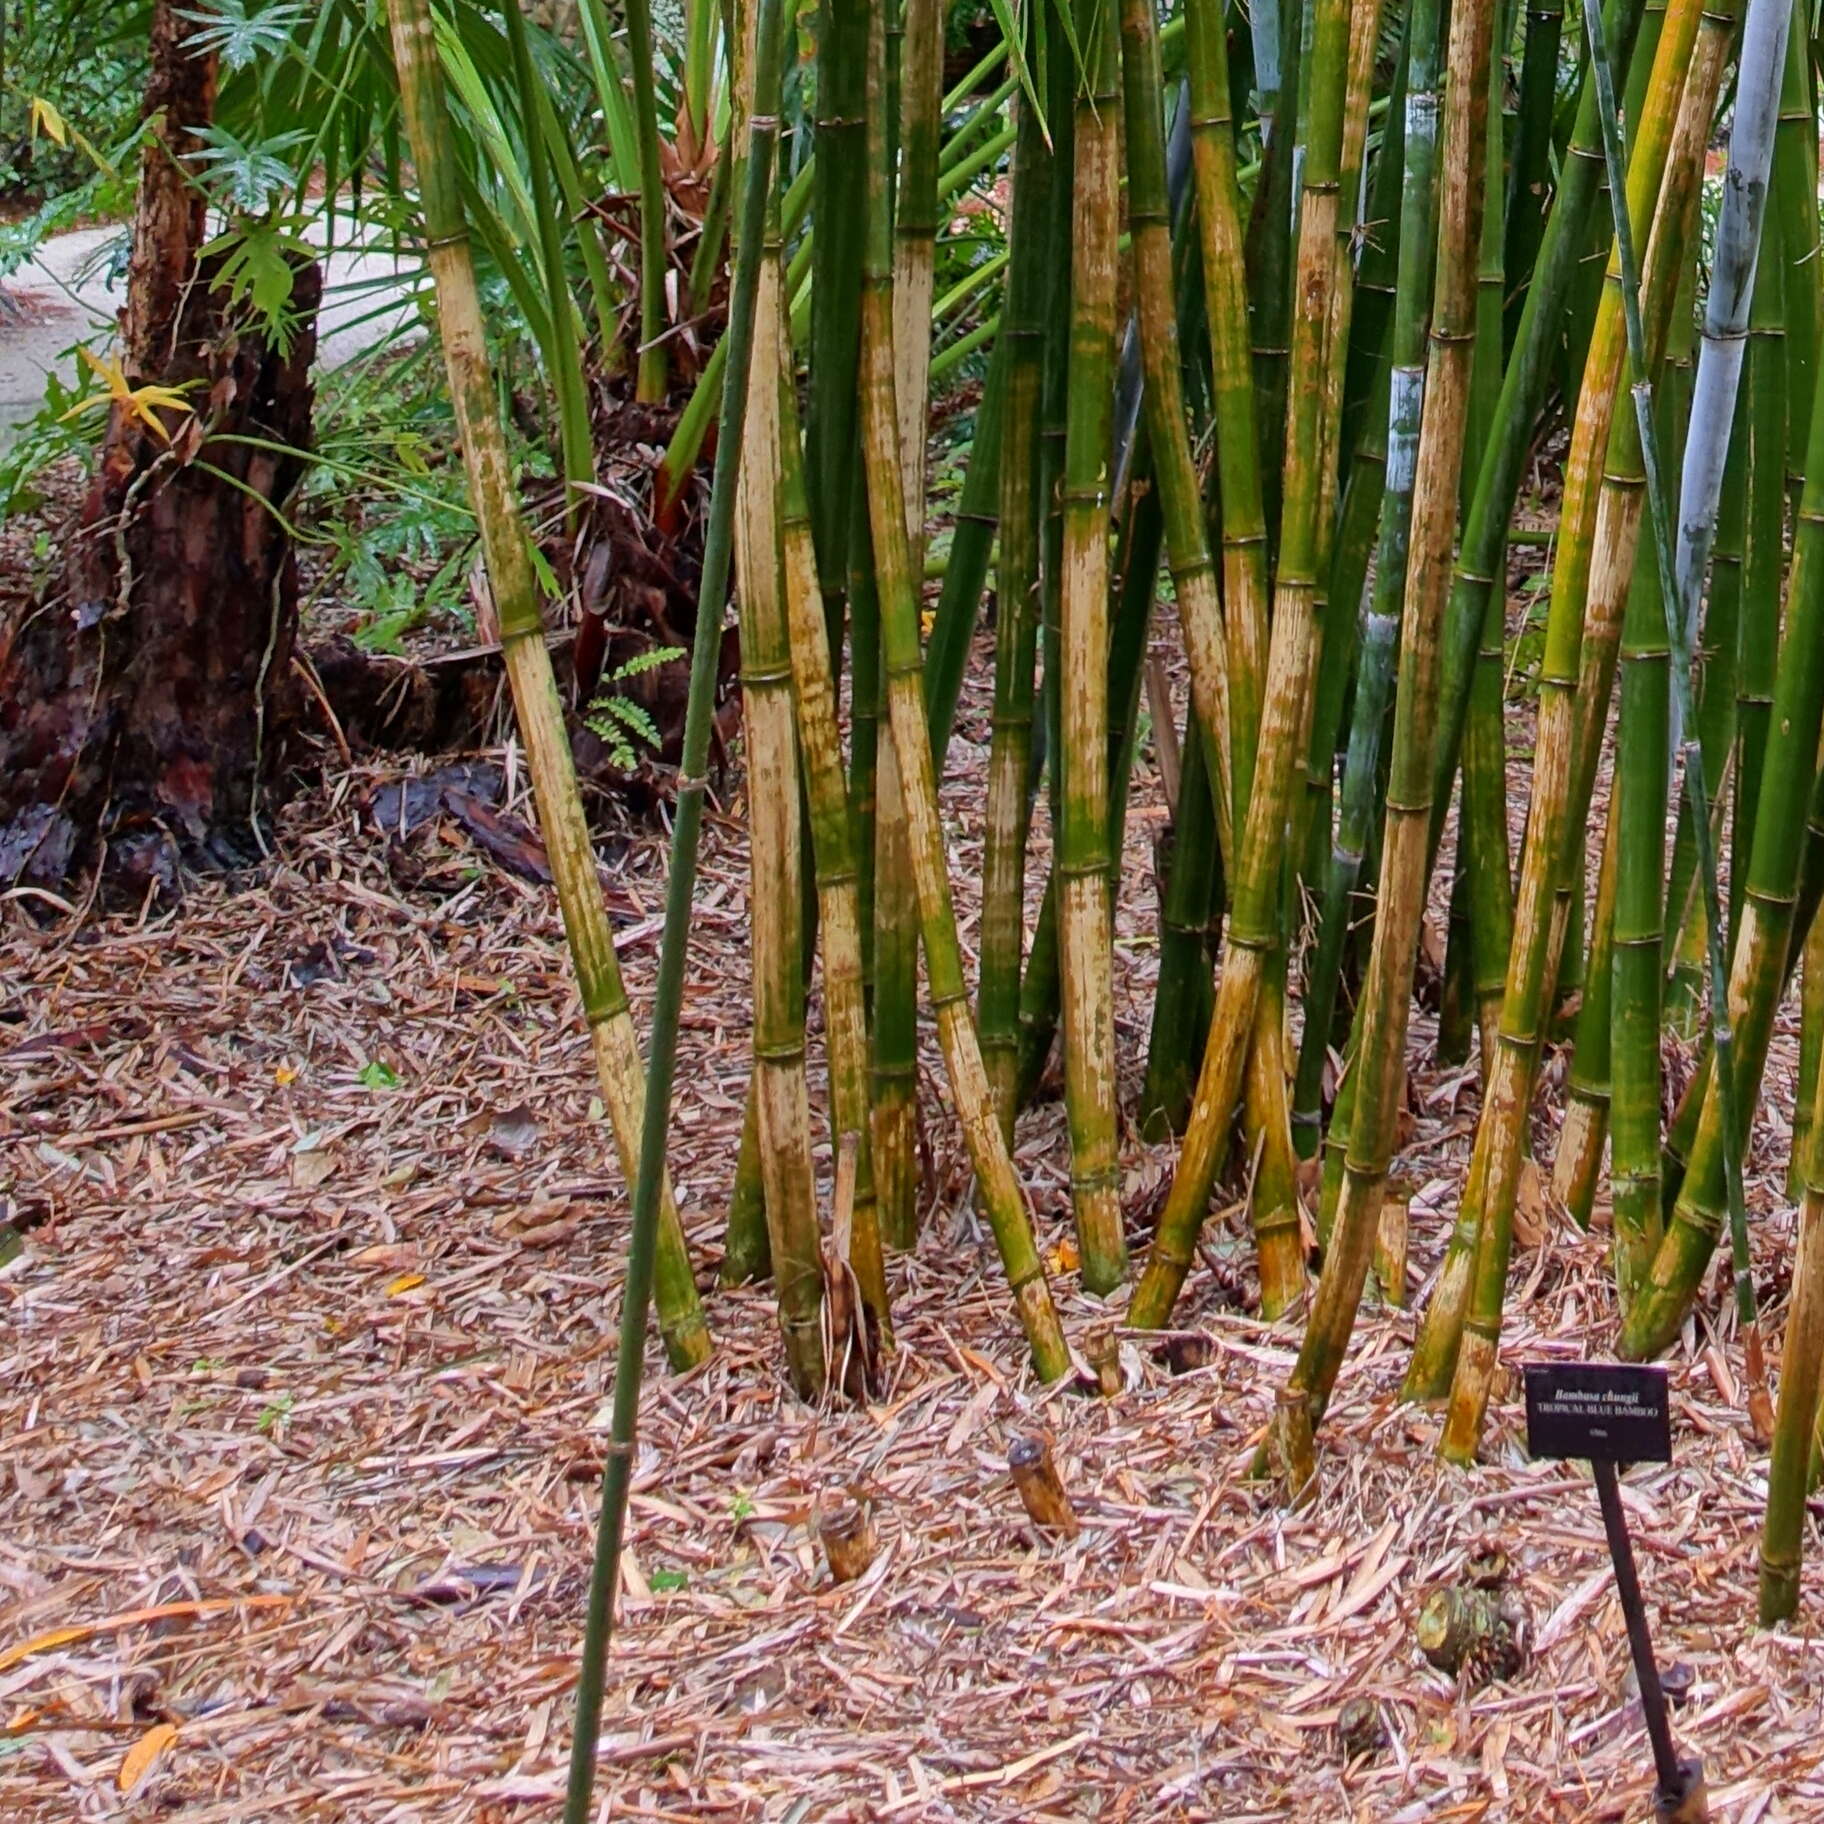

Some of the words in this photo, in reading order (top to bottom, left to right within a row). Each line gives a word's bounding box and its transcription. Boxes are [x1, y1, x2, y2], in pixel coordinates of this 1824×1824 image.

[1554, 1389, 1600, 1402] Bambusa
[1601, 1389, 1640, 1404] chungii
[1536, 1402, 1585, 1414] TROPICAL
[1586, 1403, 1613, 1415] BLUE
[1614, 1405, 1659, 1417] BAMBOO
